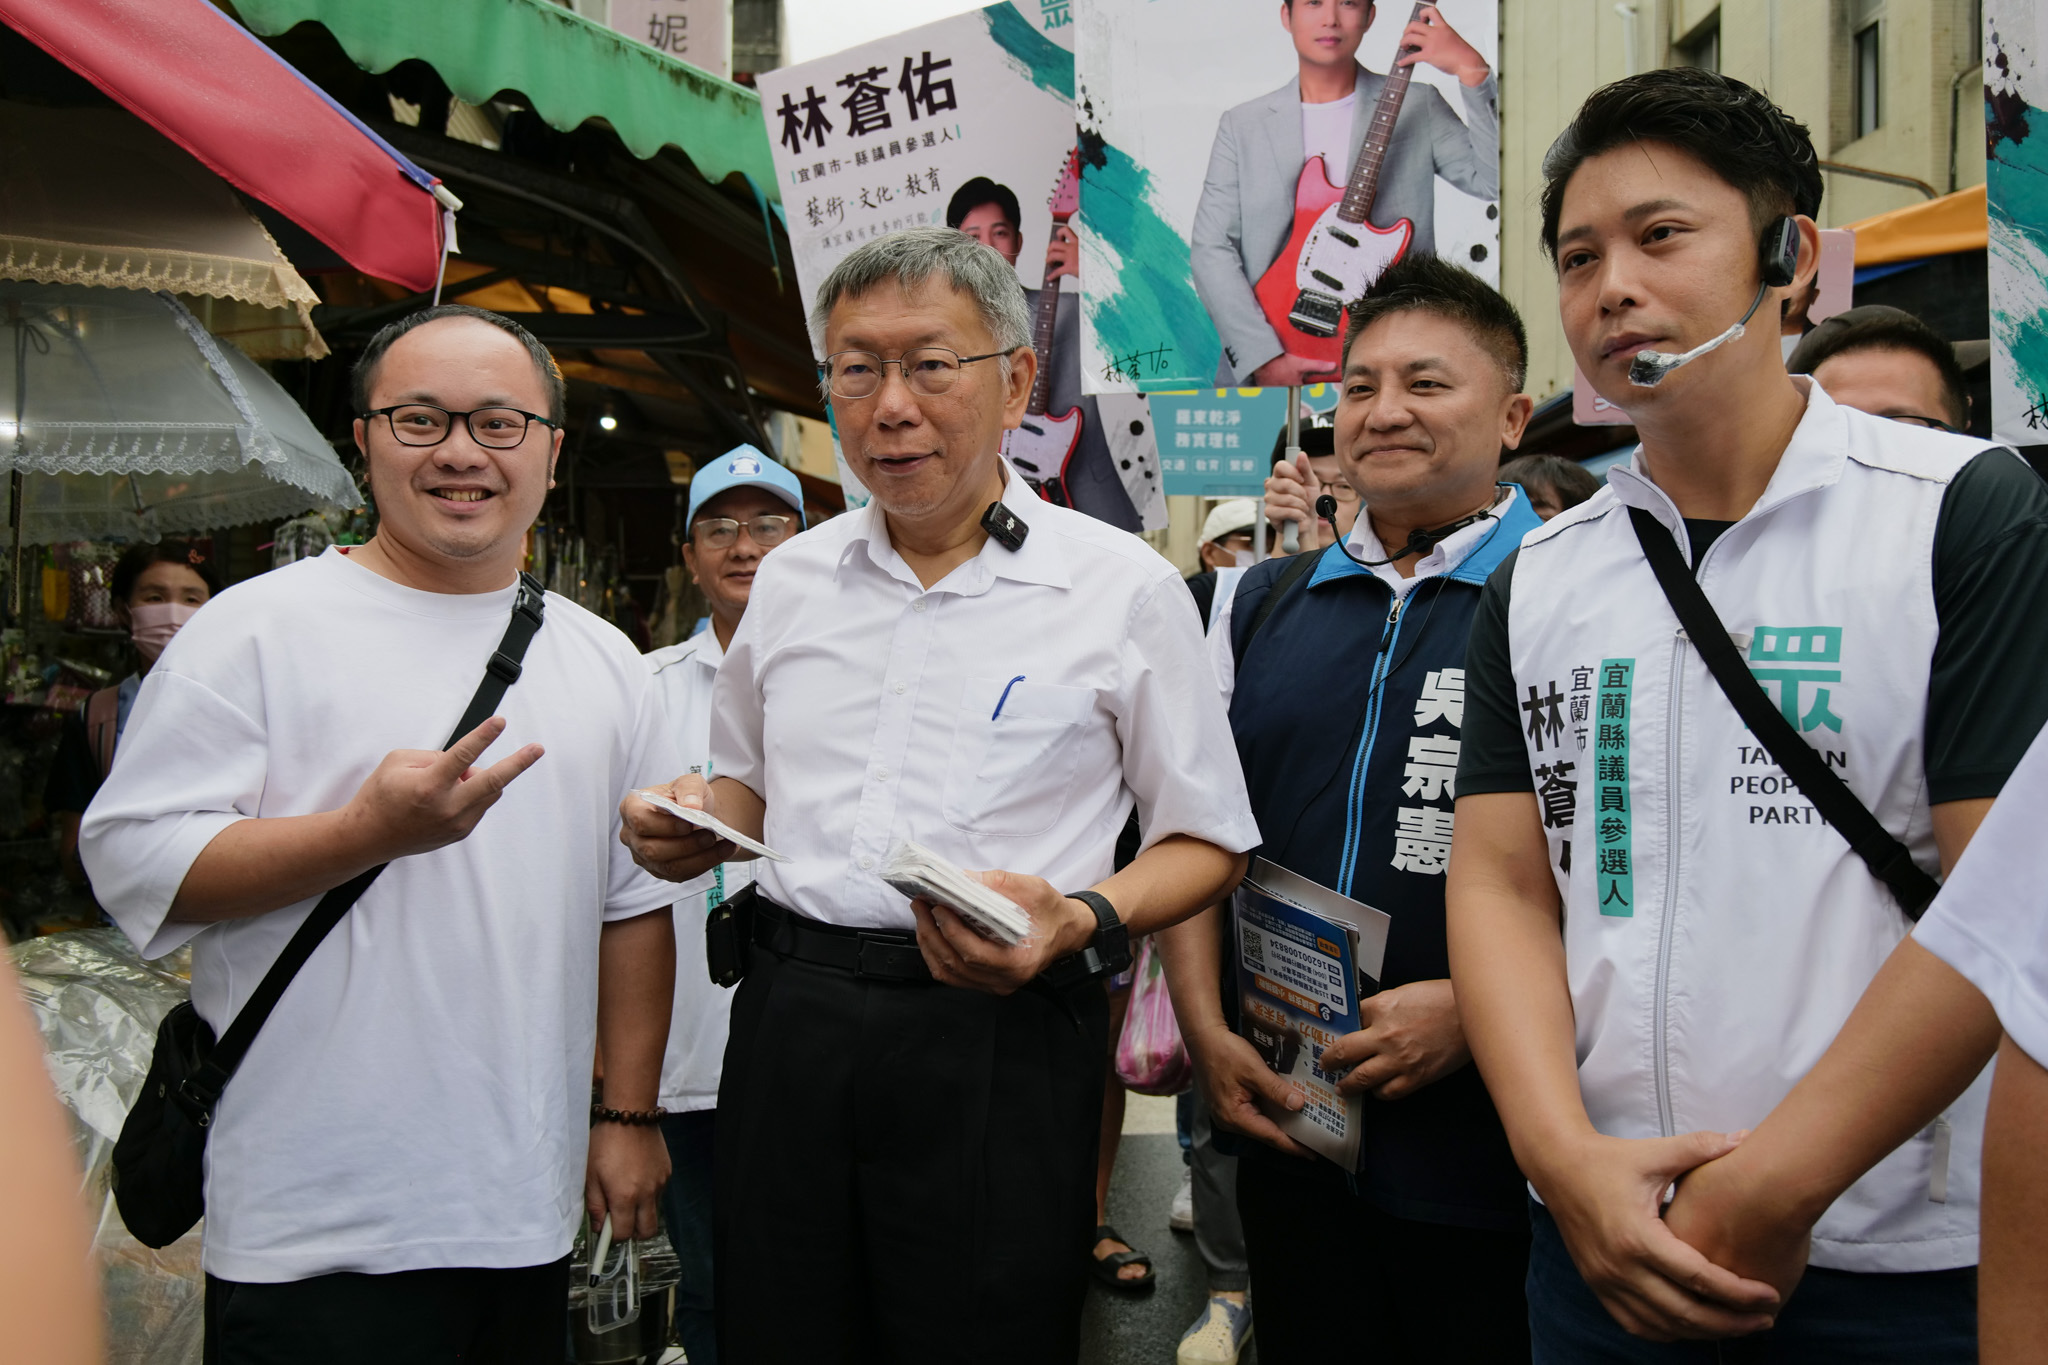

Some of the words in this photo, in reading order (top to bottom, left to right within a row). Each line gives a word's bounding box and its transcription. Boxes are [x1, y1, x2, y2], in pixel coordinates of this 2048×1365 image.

[648, 0, 688, 53] 妮
[776, 51, 959, 155] 林蒼佑
[1570, 665, 1594, 752] 宜蘭市
[1390, 667, 1466, 875] 吳宗憲
[1598, 662, 1630, 908] 宜蘭縣議員參選人
[1737, 746, 1846, 768] TAN
[1749, 806, 1827, 826] PART
[1270, 939, 1326, 969] 162001008834
